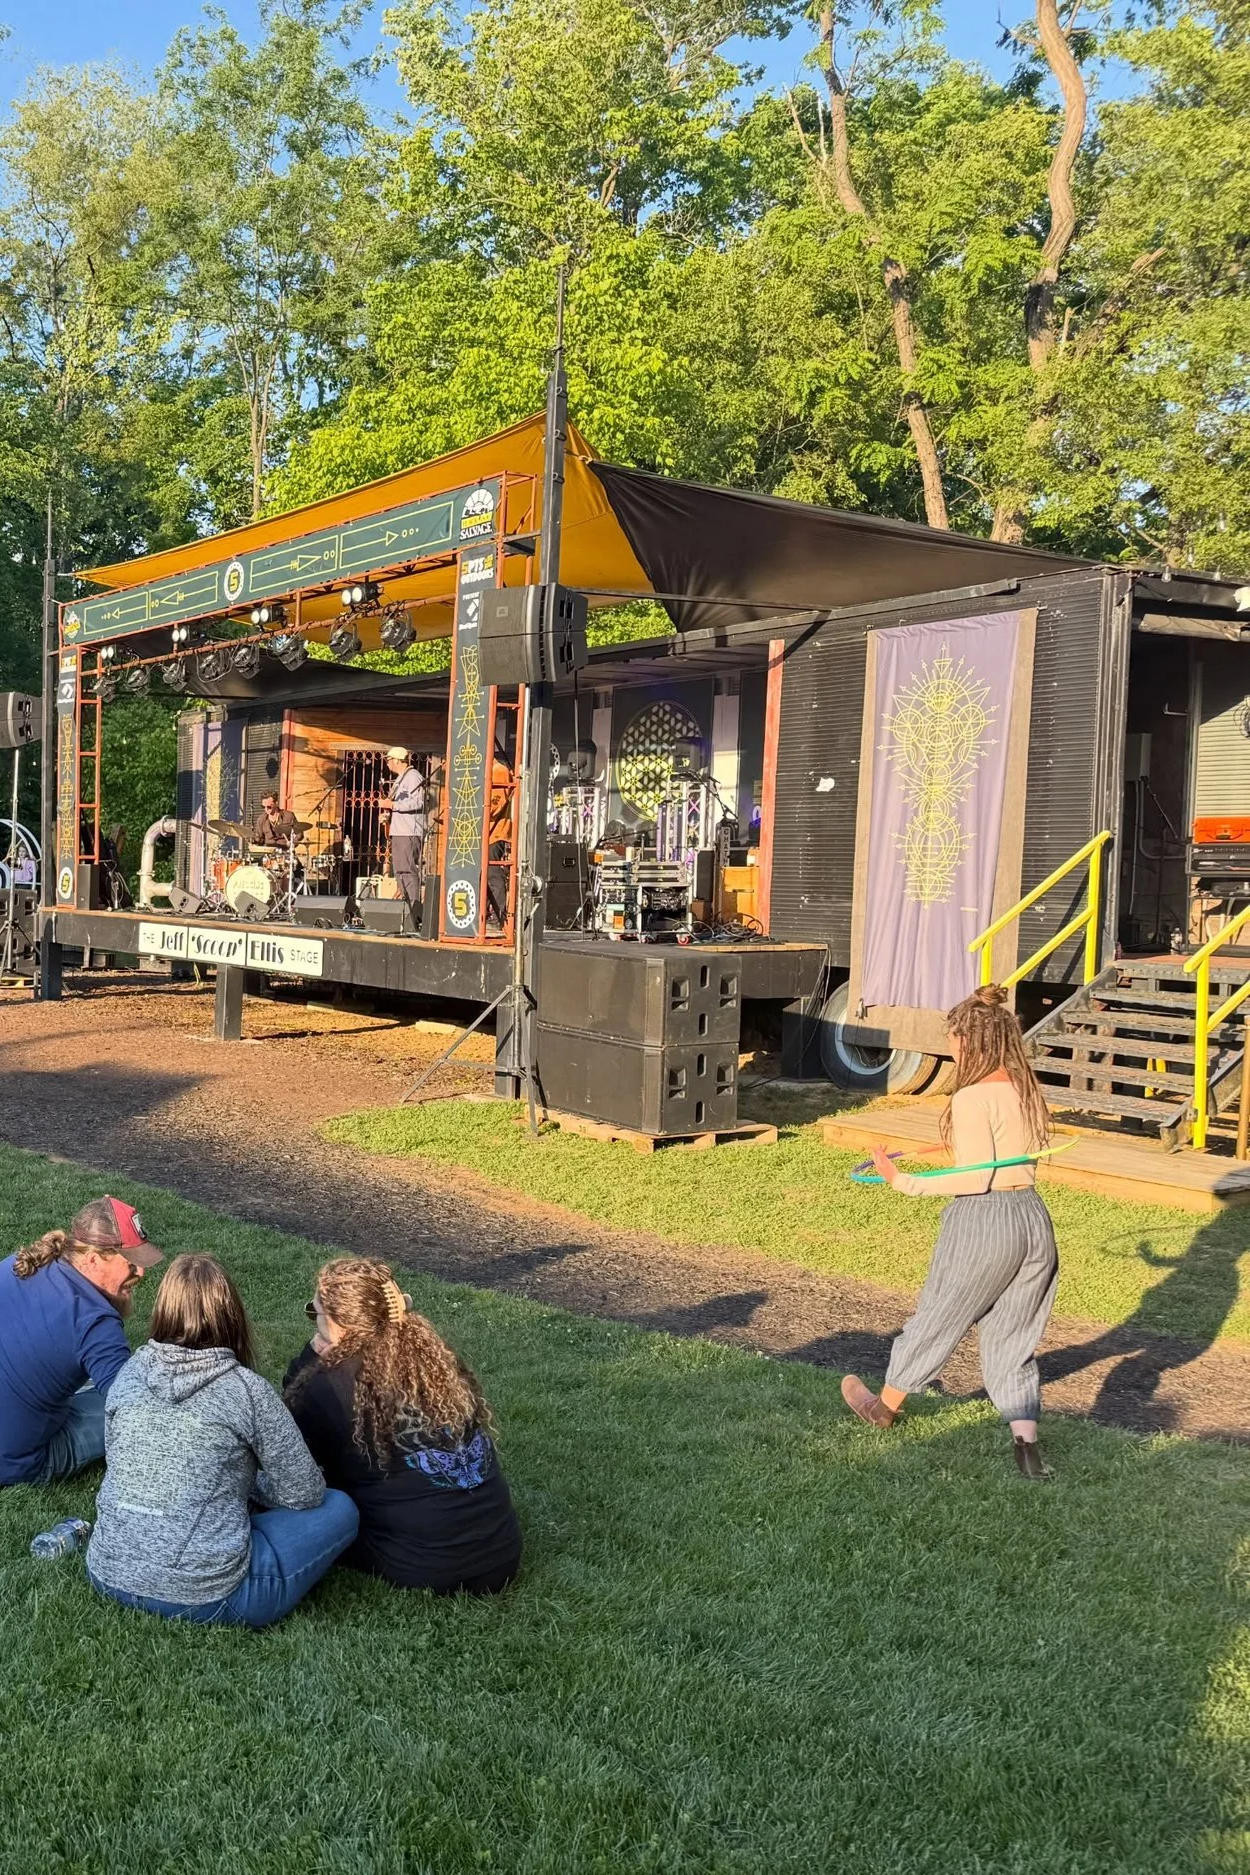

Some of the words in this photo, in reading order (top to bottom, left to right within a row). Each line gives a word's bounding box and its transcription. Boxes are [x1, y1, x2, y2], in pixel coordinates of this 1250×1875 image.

[460, 522, 493, 540] SALVAGE
[230, 571, 238, 592] 5
[61, 873, 69, 892] 5
[454, 892, 467, 917] 5
[143, 933, 154, 944] THE
[159, 931, 184, 951] Jeff
[250, 940, 284, 964] Ellis
[290, 949, 319, 964] STAGE
